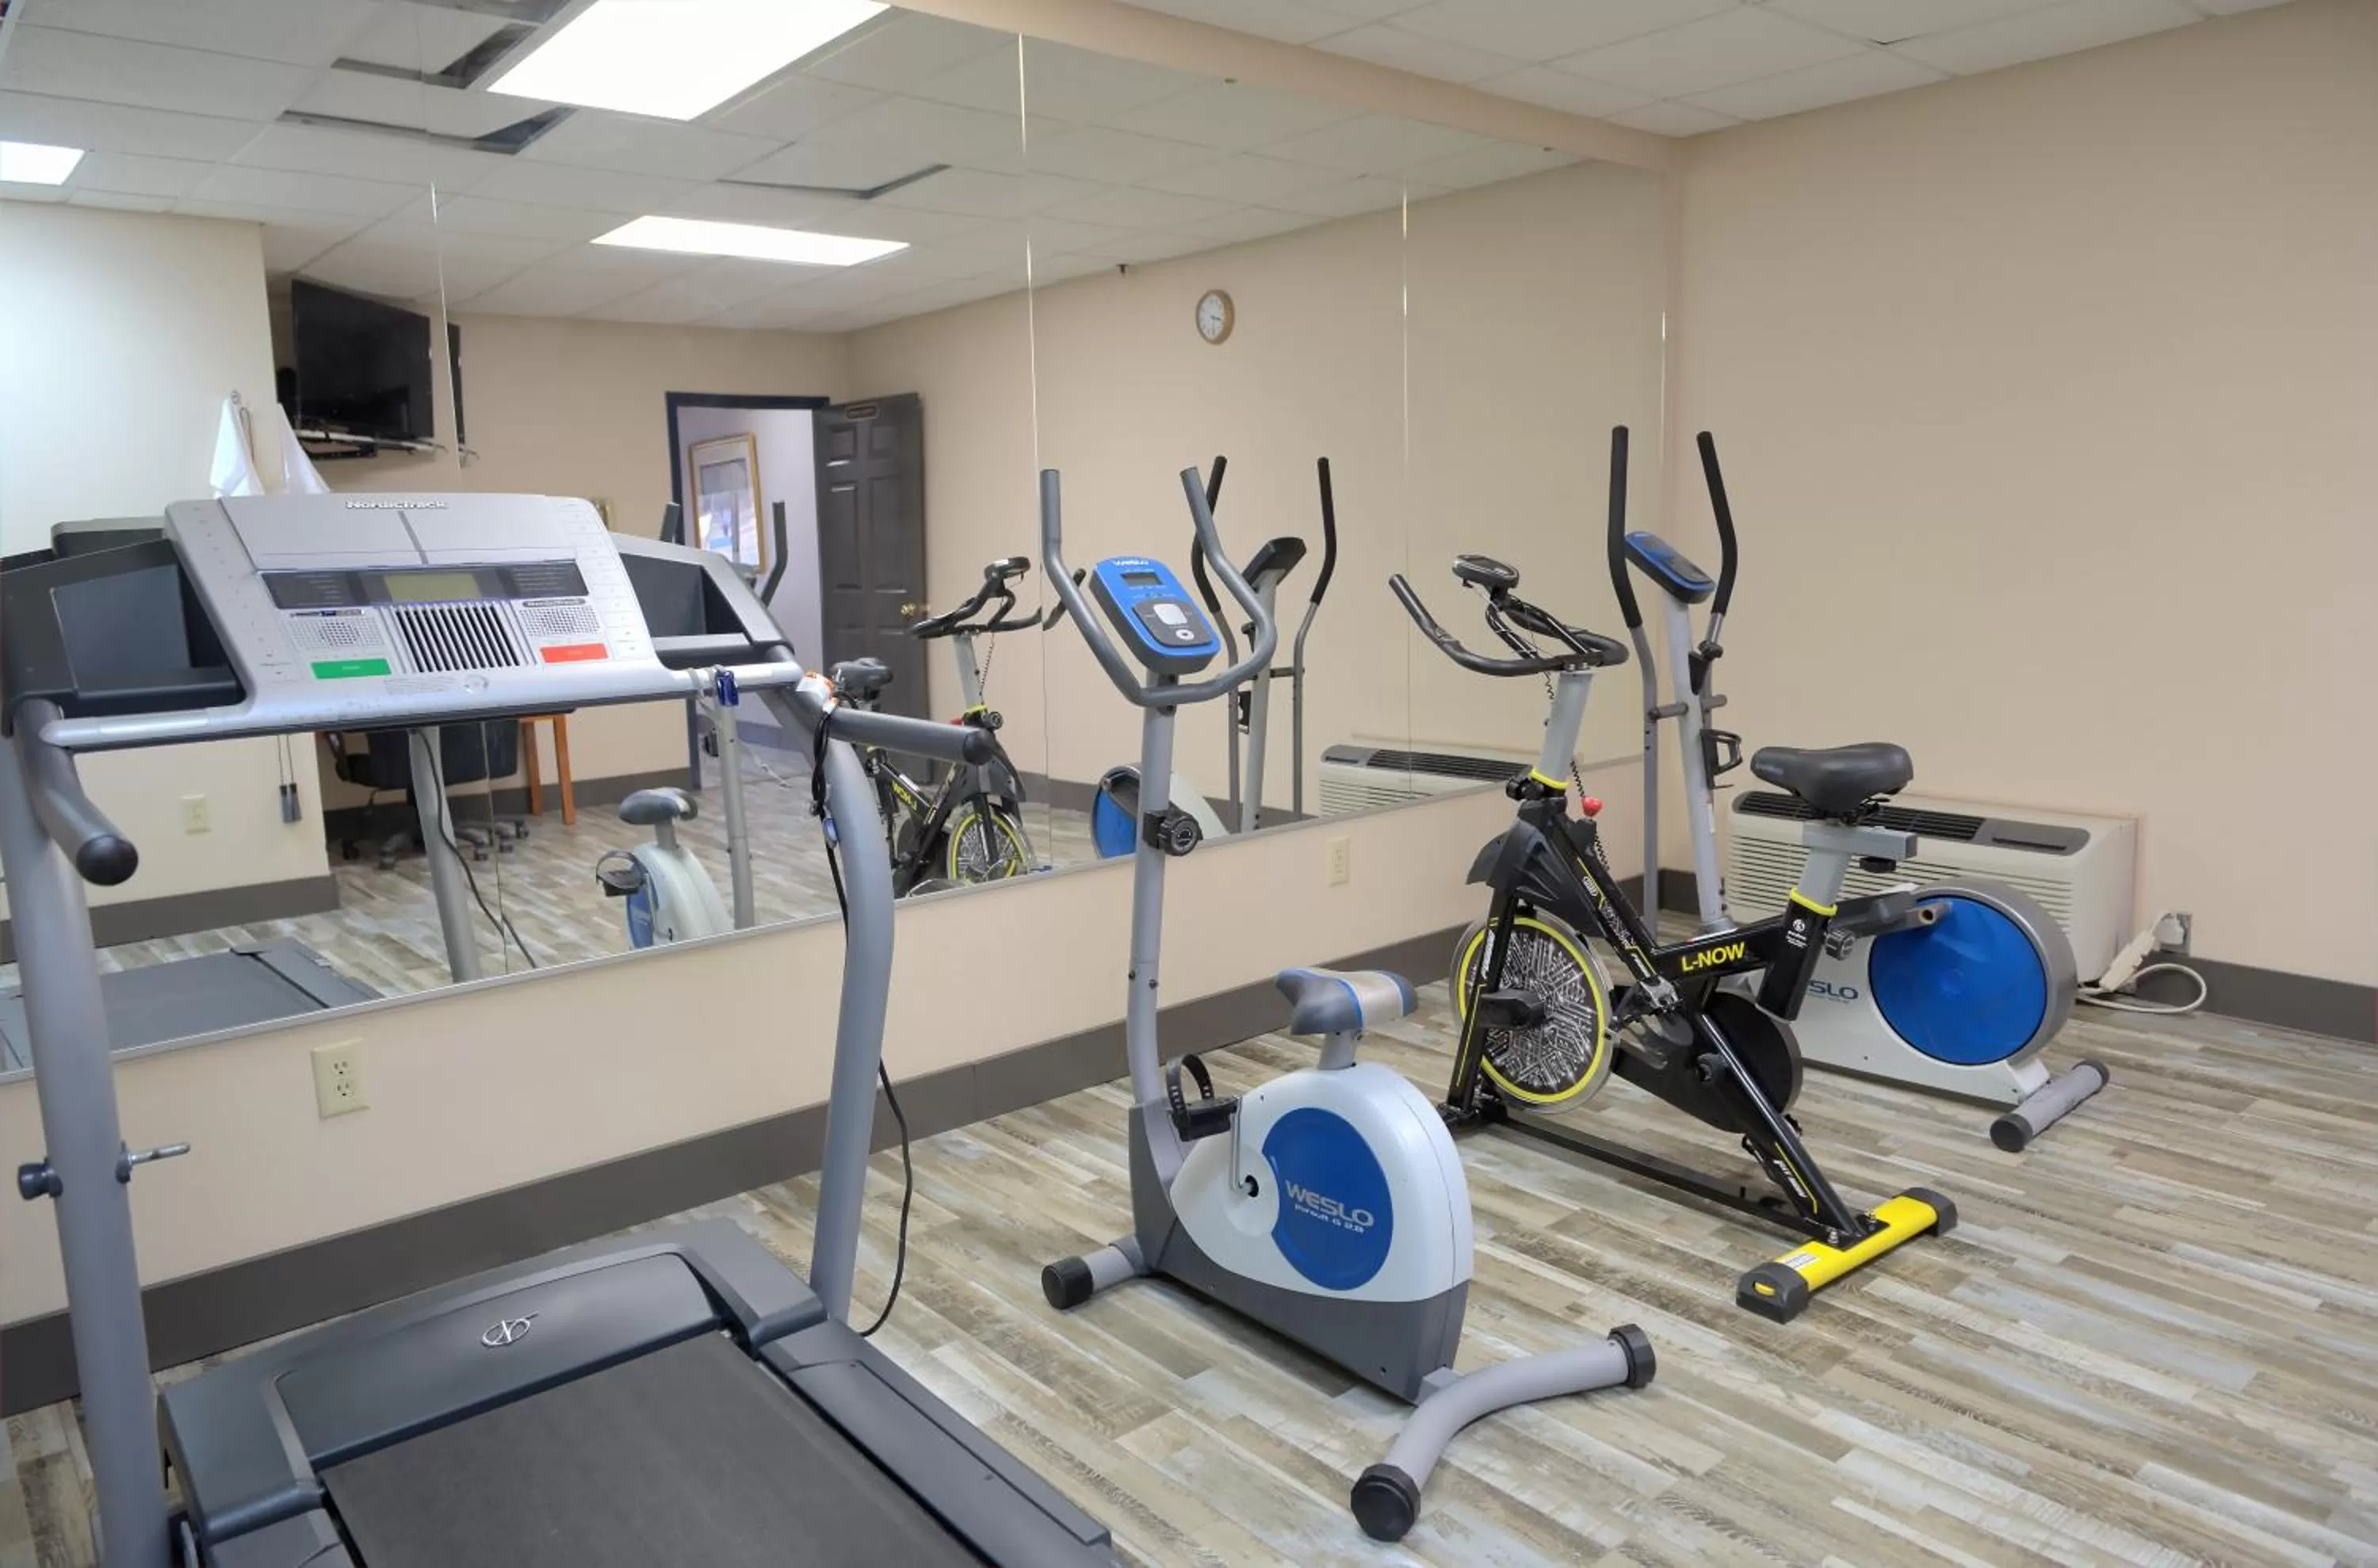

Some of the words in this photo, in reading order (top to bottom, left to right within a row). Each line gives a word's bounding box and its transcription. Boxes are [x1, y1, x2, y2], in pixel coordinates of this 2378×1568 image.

[1681, 941, 1745, 973] L-NOW
[1808, 980, 1859, 1000] SLO
[1285, 1179, 1374, 1227] WESLO
